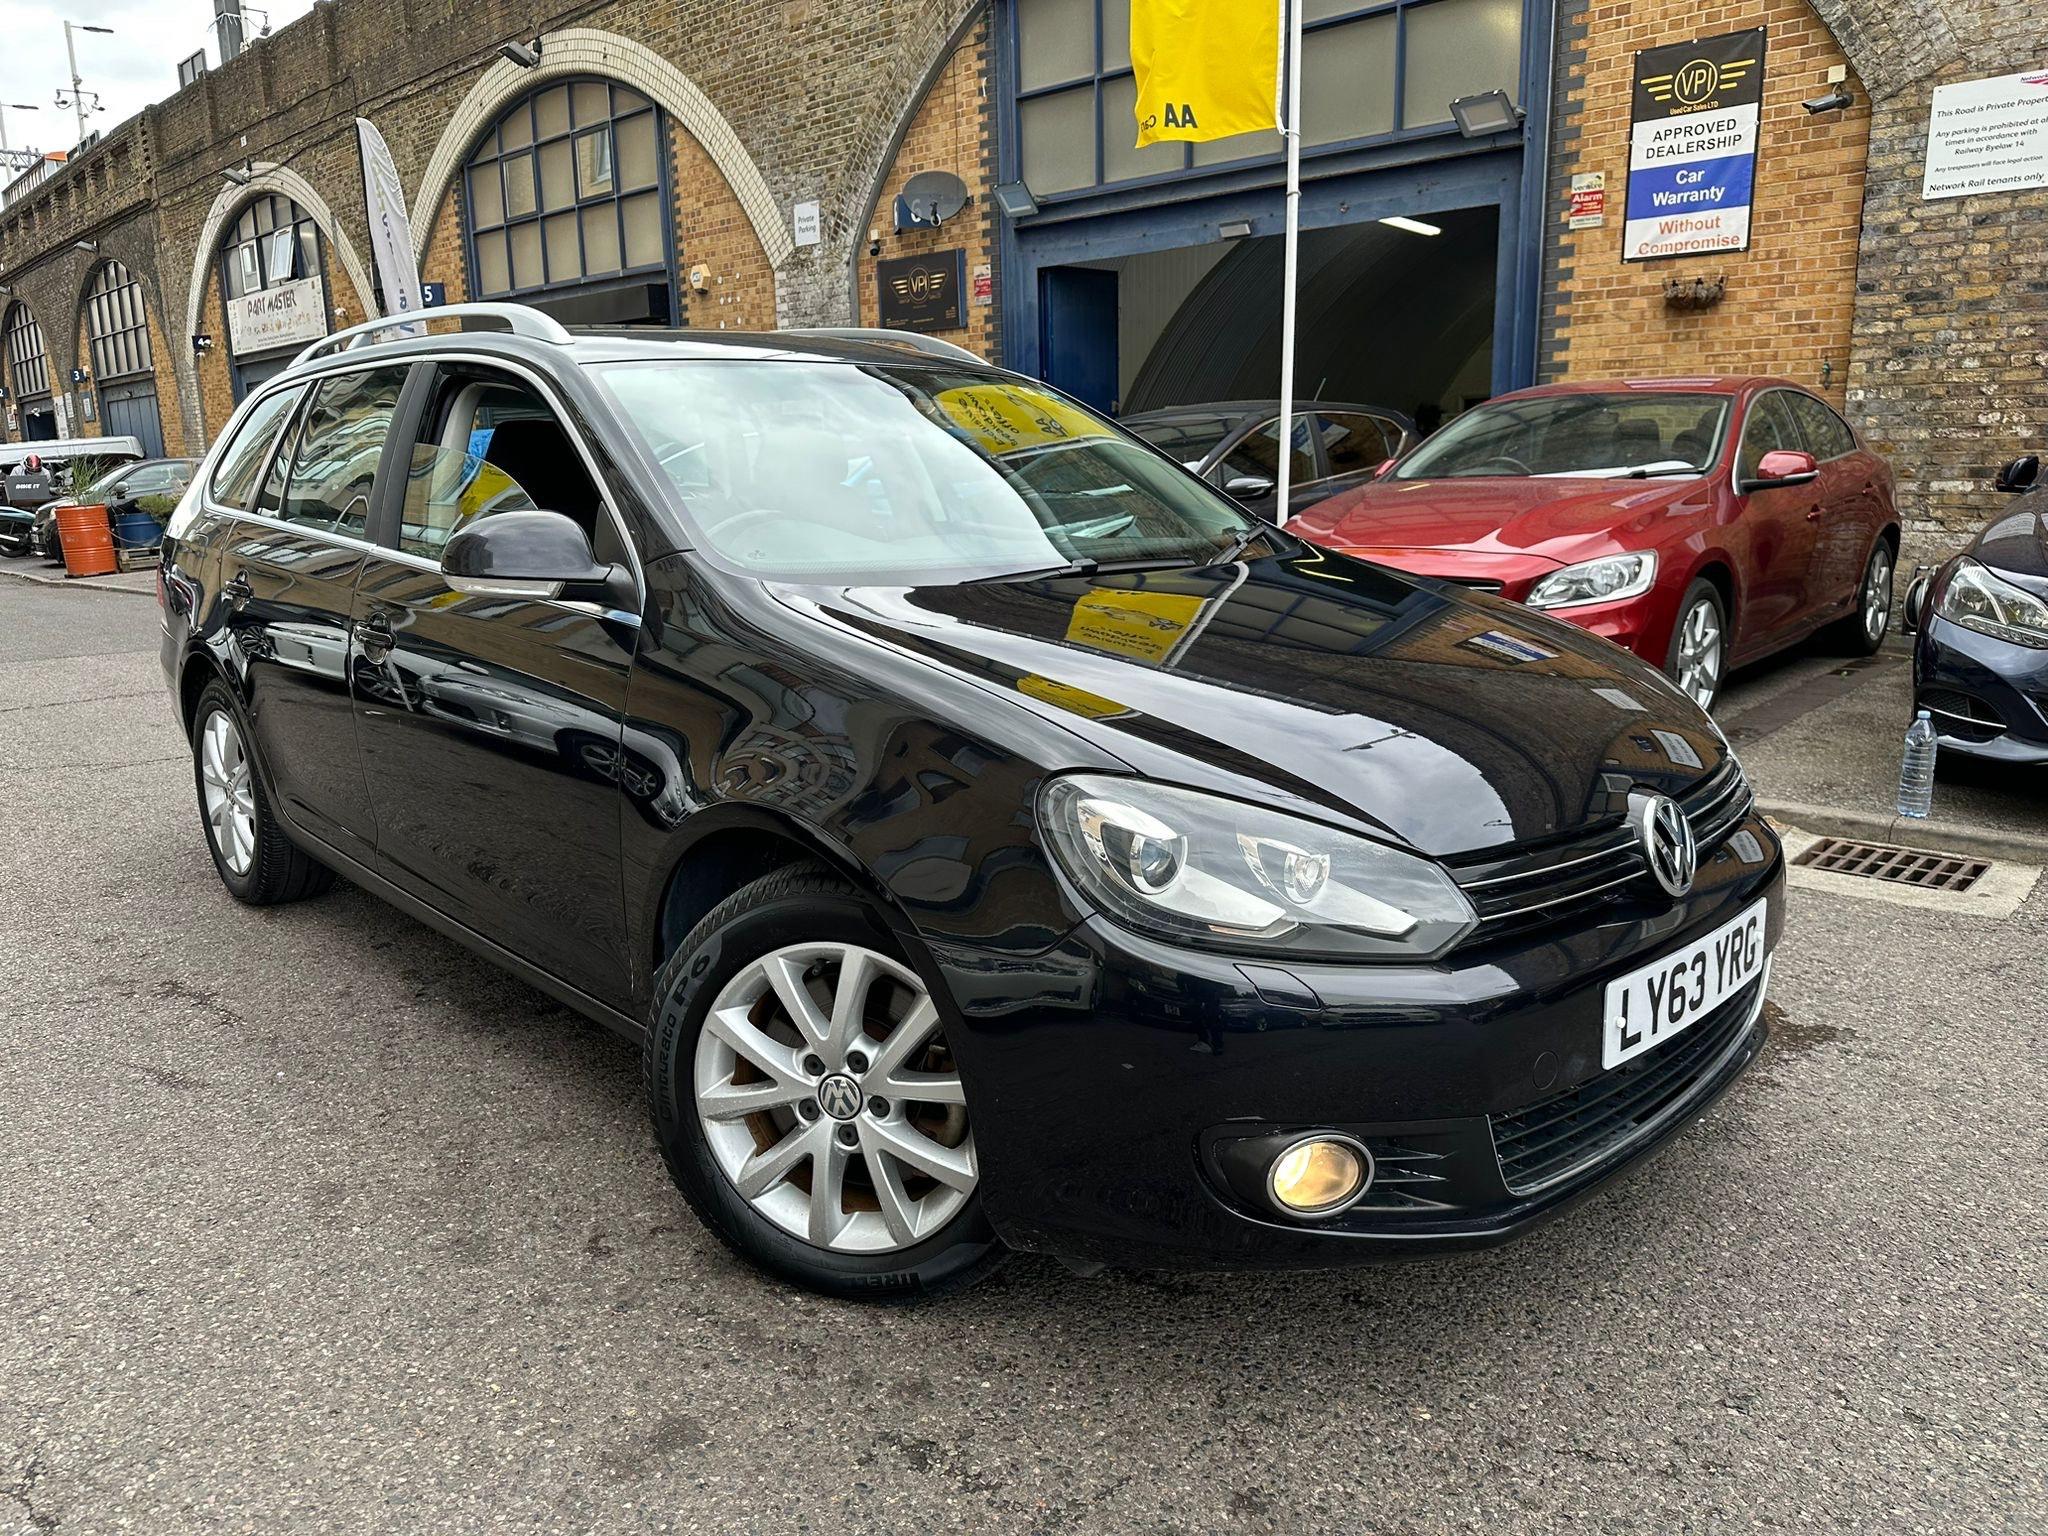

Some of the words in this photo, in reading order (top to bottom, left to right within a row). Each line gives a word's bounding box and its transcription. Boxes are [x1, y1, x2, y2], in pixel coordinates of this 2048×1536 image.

[1681, 67, 1712, 96] VPI
[1669, 107, 1683, 115] Used
[1683, 105, 1692, 113] Car
[1693, 103, 1707, 112] Sales
[1707, 101, 1719, 109] LTD
[1955, 106, 1976, 115] Road
[1977, 104, 1984, 112] is
[1986, 101, 2015, 111] Private
[2017, 96, 2048, 106] Propert
[1652, 118, 1737, 142] APPROVED
[1935, 131, 1950, 139] Any
[1951, 126, 1980, 138] parking
[1981, 124, 1987, 132] is
[1988, 120, 2029, 132] prohibited
[1945, 138, 1965, 147] times
[1967, 136, 1974, 144] in
[1975, 132, 2019, 142] accordance
[2020, 128, 2038, 136] with
[1646, 134, 1742, 159] DEALERSHIP
[1955, 145, 1984, 156] Railway
[1985, 143, 2013, 152] Byelaw
[1947, 163, 1980, 172] trespassers
[2007, 157, 2022, 165] legal
[1676, 169, 1705, 185] Car
[1929, 181, 1966, 192] Network
[1968, 179, 1985, 187] Rail
[1987, 174, 2022, 185] tenants
[2024, 172, 2044, 182] only
[1572, 193, 1603, 203] Alarm
[1652, 186, 1725, 207] Warranty
[1659, 216, 1721, 235] Without
[1638, 235, 1740, 255] Compromise
[424, 285, 433, 302] 5
[911, 275, 928, 293] VPI
[248, 297, 266, 317] PART
[268, 289, 297, 312] MASTER
[73, 370, 80, 381] 3
[672, 955, 710, 1006] P6
[1620, 950, 1707, 1052] LY63
[1715, 915, 1757, 995] YRG
